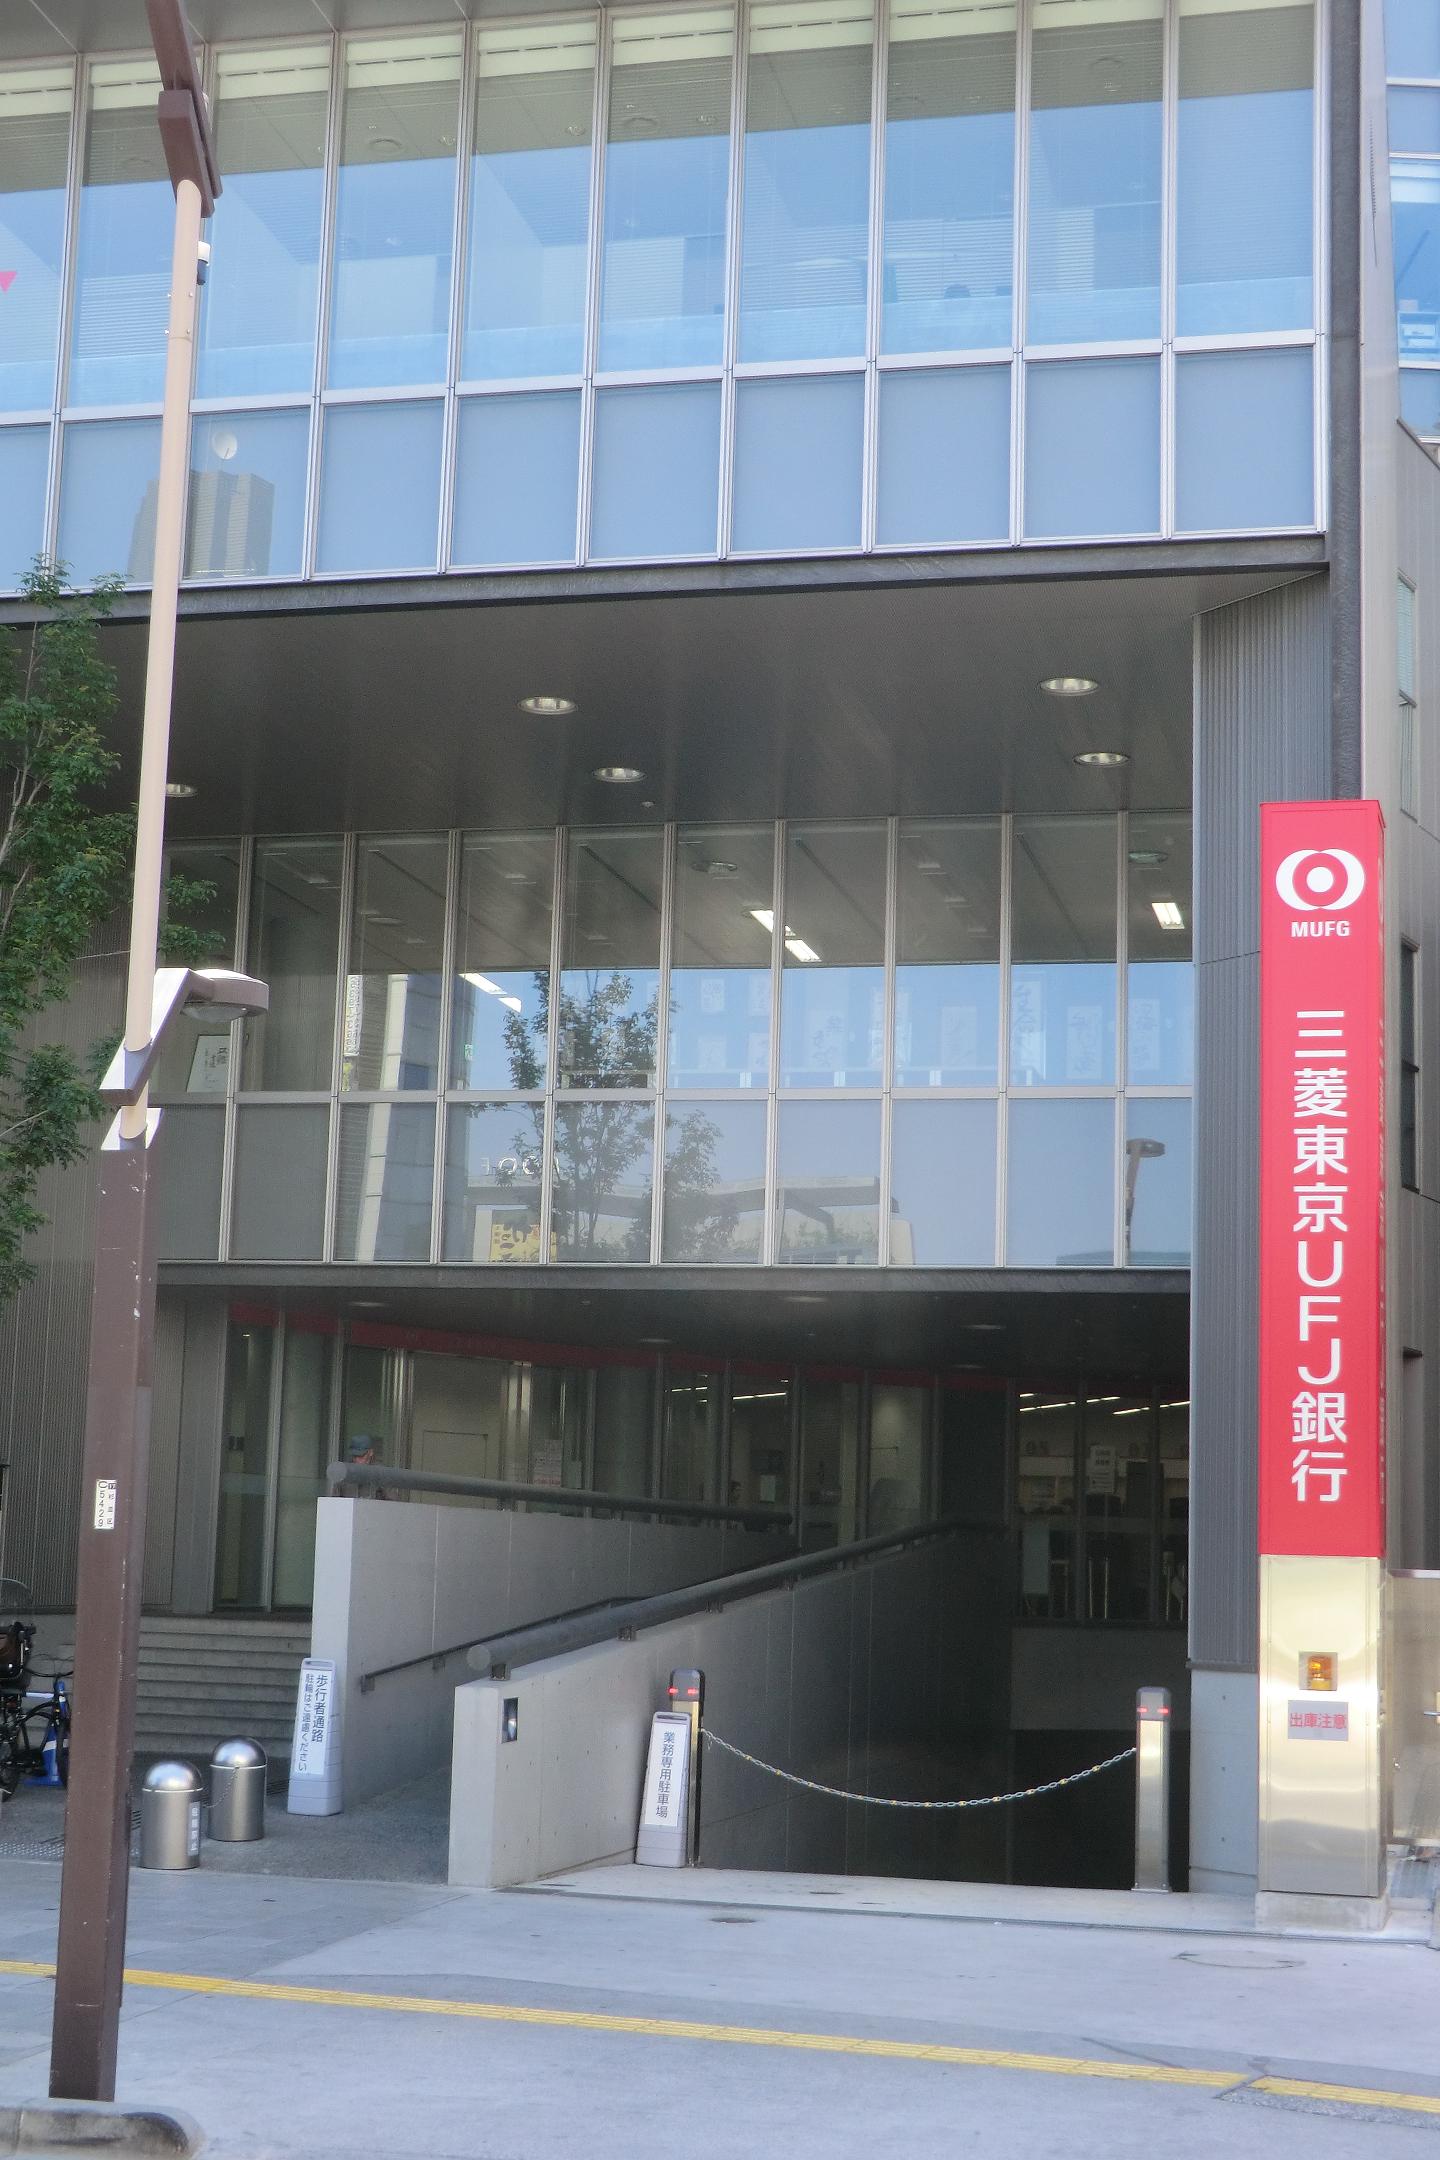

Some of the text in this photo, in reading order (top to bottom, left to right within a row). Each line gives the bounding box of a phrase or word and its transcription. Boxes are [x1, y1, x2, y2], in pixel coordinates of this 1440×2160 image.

[1290, 920, 1350, 937] MUFG
[1292, 1010, 1348, 1502] 三菱東京UFJ銀行
[298, 1673, 314, 1772] 駐輪はご遠慮ください
[311, 1674, 328, 1743] 歩行者通路
[656, 1731, 675, 1818] 業務専用駐車場
